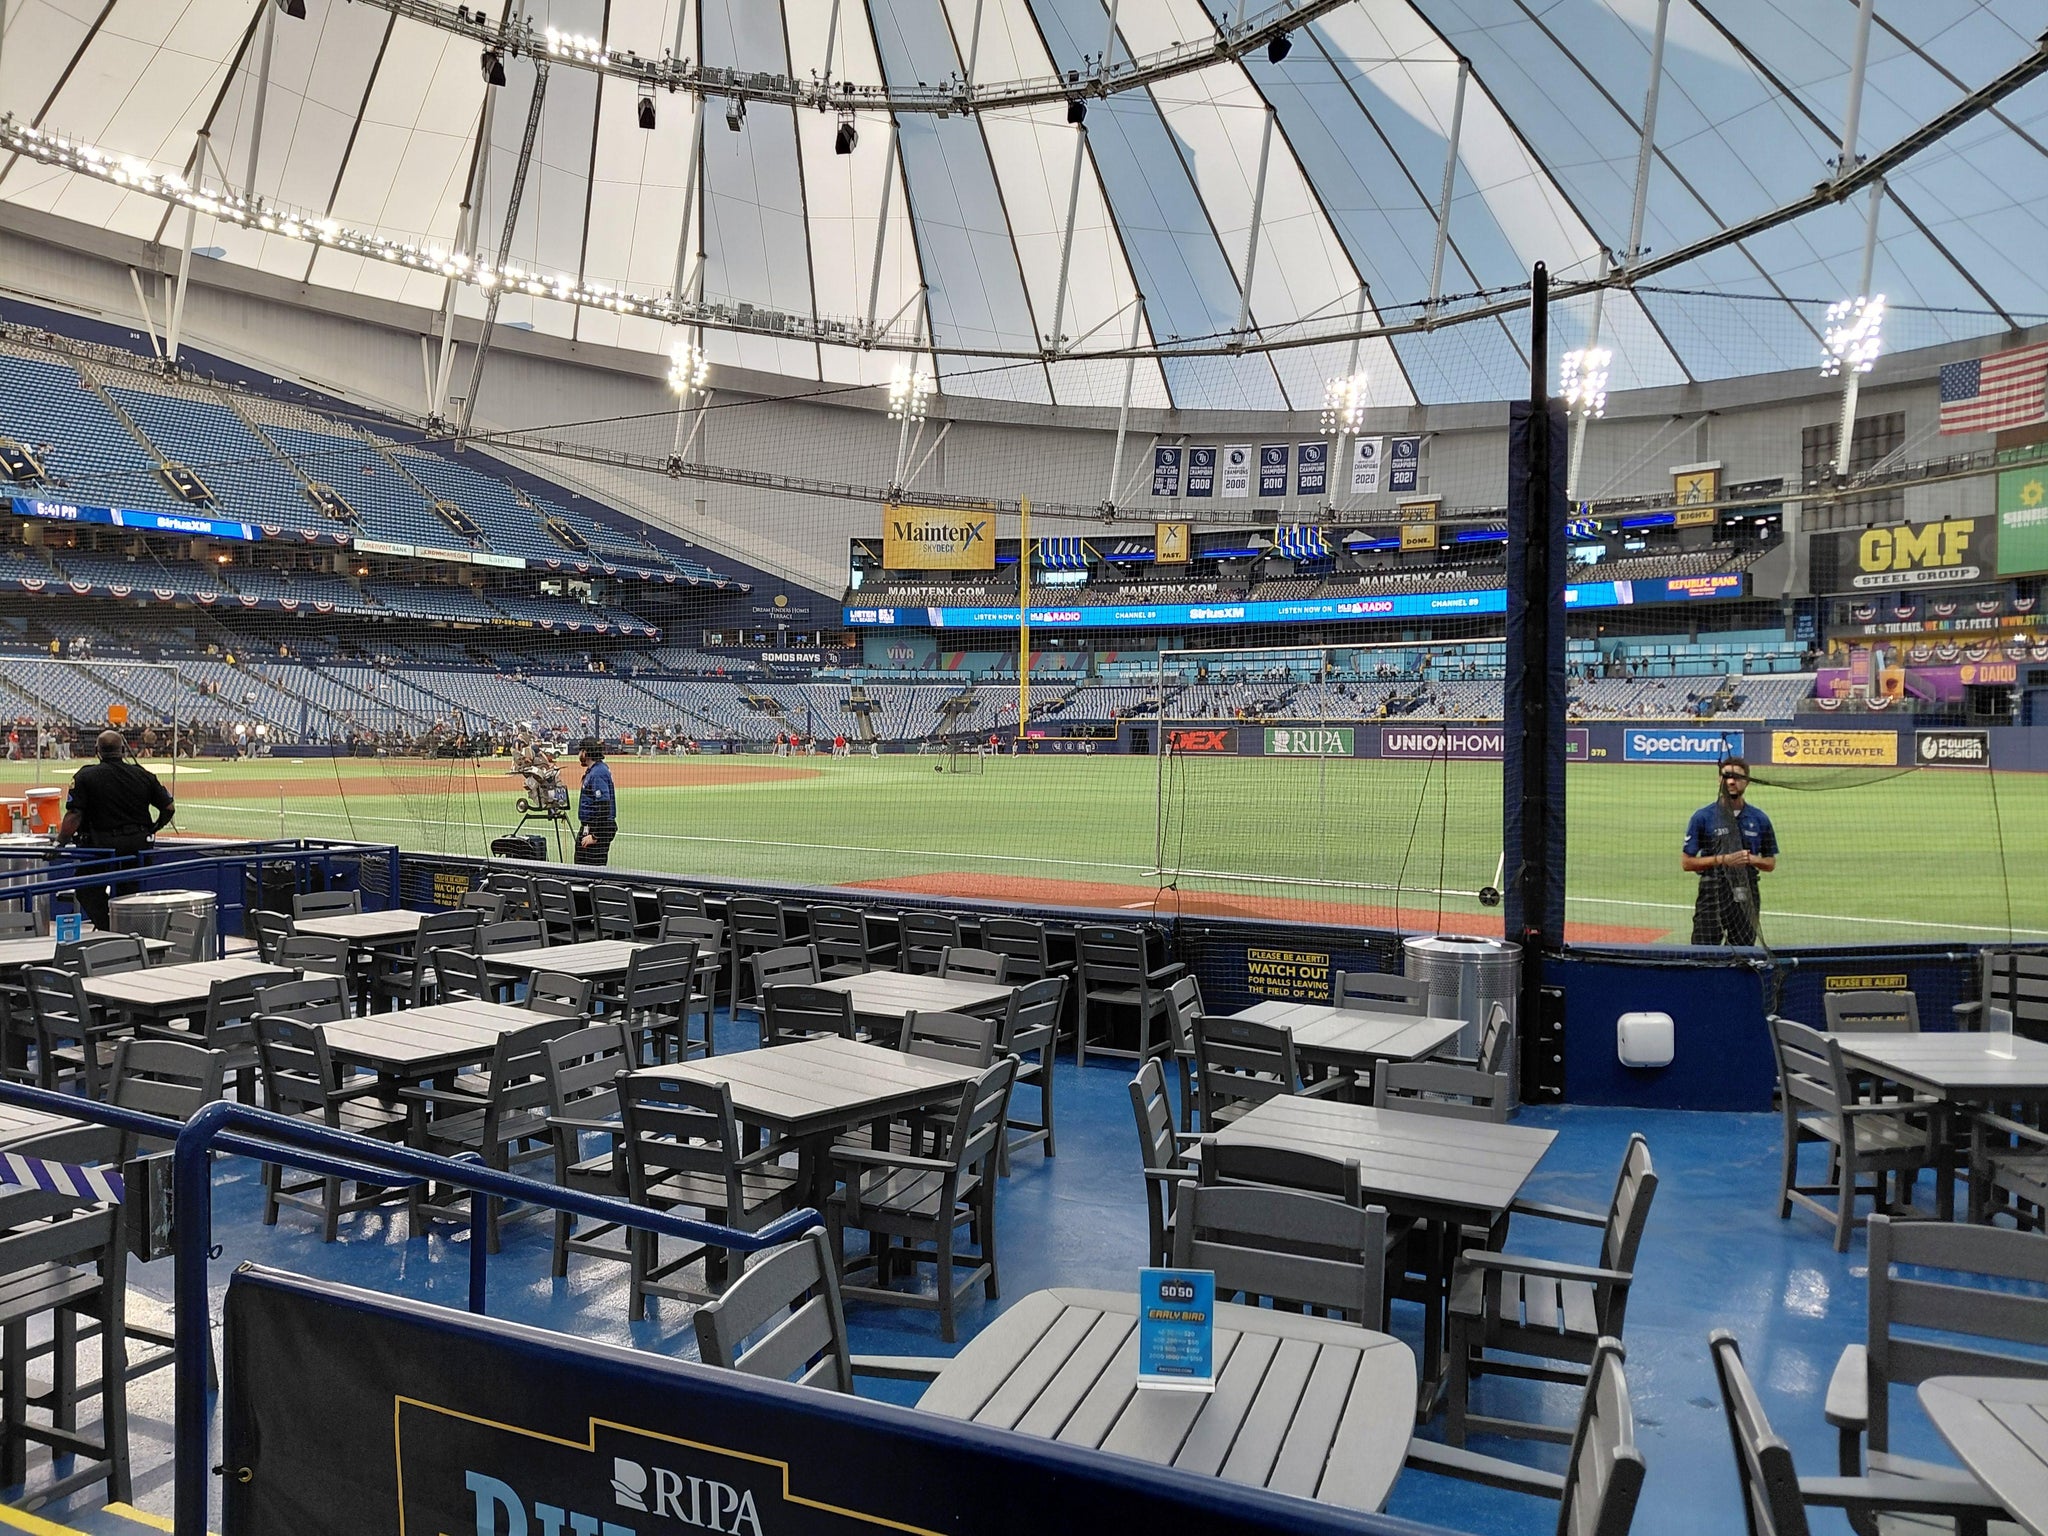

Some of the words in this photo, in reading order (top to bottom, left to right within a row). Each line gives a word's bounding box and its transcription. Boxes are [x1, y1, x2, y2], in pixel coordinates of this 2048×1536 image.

[1301, 475, 1323, 487] 2020
[1355, 474, 1375, 484] 2020
[1393, 471, 1413, 484] 2021
[1190, 479, 1210, 490] 2008
[1226, 479, 1246, 489] 2008
[1263, 478, 1283, 489] 2010
[61, 505, 77, 519] PM
[1680, 511, 1710, 521] RIGHT.
[157, 516, 212, 532] SiriusXM
[892, 520, 987, 552] MaintenX
[1406, 537, 1431, 545] DONE.
[923, 544, 955, 553] SKYDECK
[1859, 519, 1975, 572] GMF
[1668, 578, 1711, 590] REPUBLIC
[1711, 575, 1738, 587] BANK
[1862, 574, 1909, 585] STEEL
[1917, 569, 1970, 583] GROUP
[888, 586, 985, 597] MAINTENX.COM
[1119, 583, 1217, 594] MAINTENX.COM
[1362, 601, 1392, 612] RADIO
[1431, 600, 1467, 608] CHANNEL
[353, 608, 393, 616] Assistance?
[456, 615, 482, 623] Location
[850, 610, 876, 618] LISTEN
[1053, 612, 1080, 621] RADIO
[1190, 608, 1244, 619] SiriusXM
[1864, 624, 1877, 635] WE
[1885, 623, 1900, 633] THE
[1901, 621, 1924, 633] RAYS.
[1925, 620, 1938, 631] WE
[1970, 617, 1991, 630] PETE
[761, 652, 797, 662] SOMOS
[797, 652, 821, 662] RAYS
[887, 648, 914, 660] VIVA
[1979, 664, 2017, 682] DAIQU
[1293, 730, 1346, 753] RIPA
[1633, 734, 1727, 753] Spectrum
[1803, 738, 1820, 746] ST.
[1821, 738, 1850, 747] PETE
[1938, 738, 1982, 749] POWER
[1591, 749, 1607, 757] 378
[1803, 747, 1884, 756] CLEARWATER
[1938, 748, 1982, 759] DESIGN
[434, 883, 455, 893] WATCH
[1252, 951, 1281, 960] PLEASE
[1296, 955, 1324, 963] ALERT!
[1248, 963, 1296, 977] WATCH
[1300, 967, 1329, 980] OUT
[1248, 976, 1265, 984] FOR
[1266, 978, 1291, 986] BALLS
[1293, 980, 1329, 990] LEAVING
[1830, 979, 1860, 987] PLEASE
[1874, 977, 1903, 986] ALERT!
[1248, 986, 1264, 994] THE
[1267, 987, 1290, 996] FIELD
[1293, 990, 1305, 998] OF
[1308, 991, 1329, 1000] PLAY
[1149, 1309, 1180, 1319] EARLY
[1181, 1311, 1205, 1321] BIRD
[651, 1466, 762, 1536] RIPA
